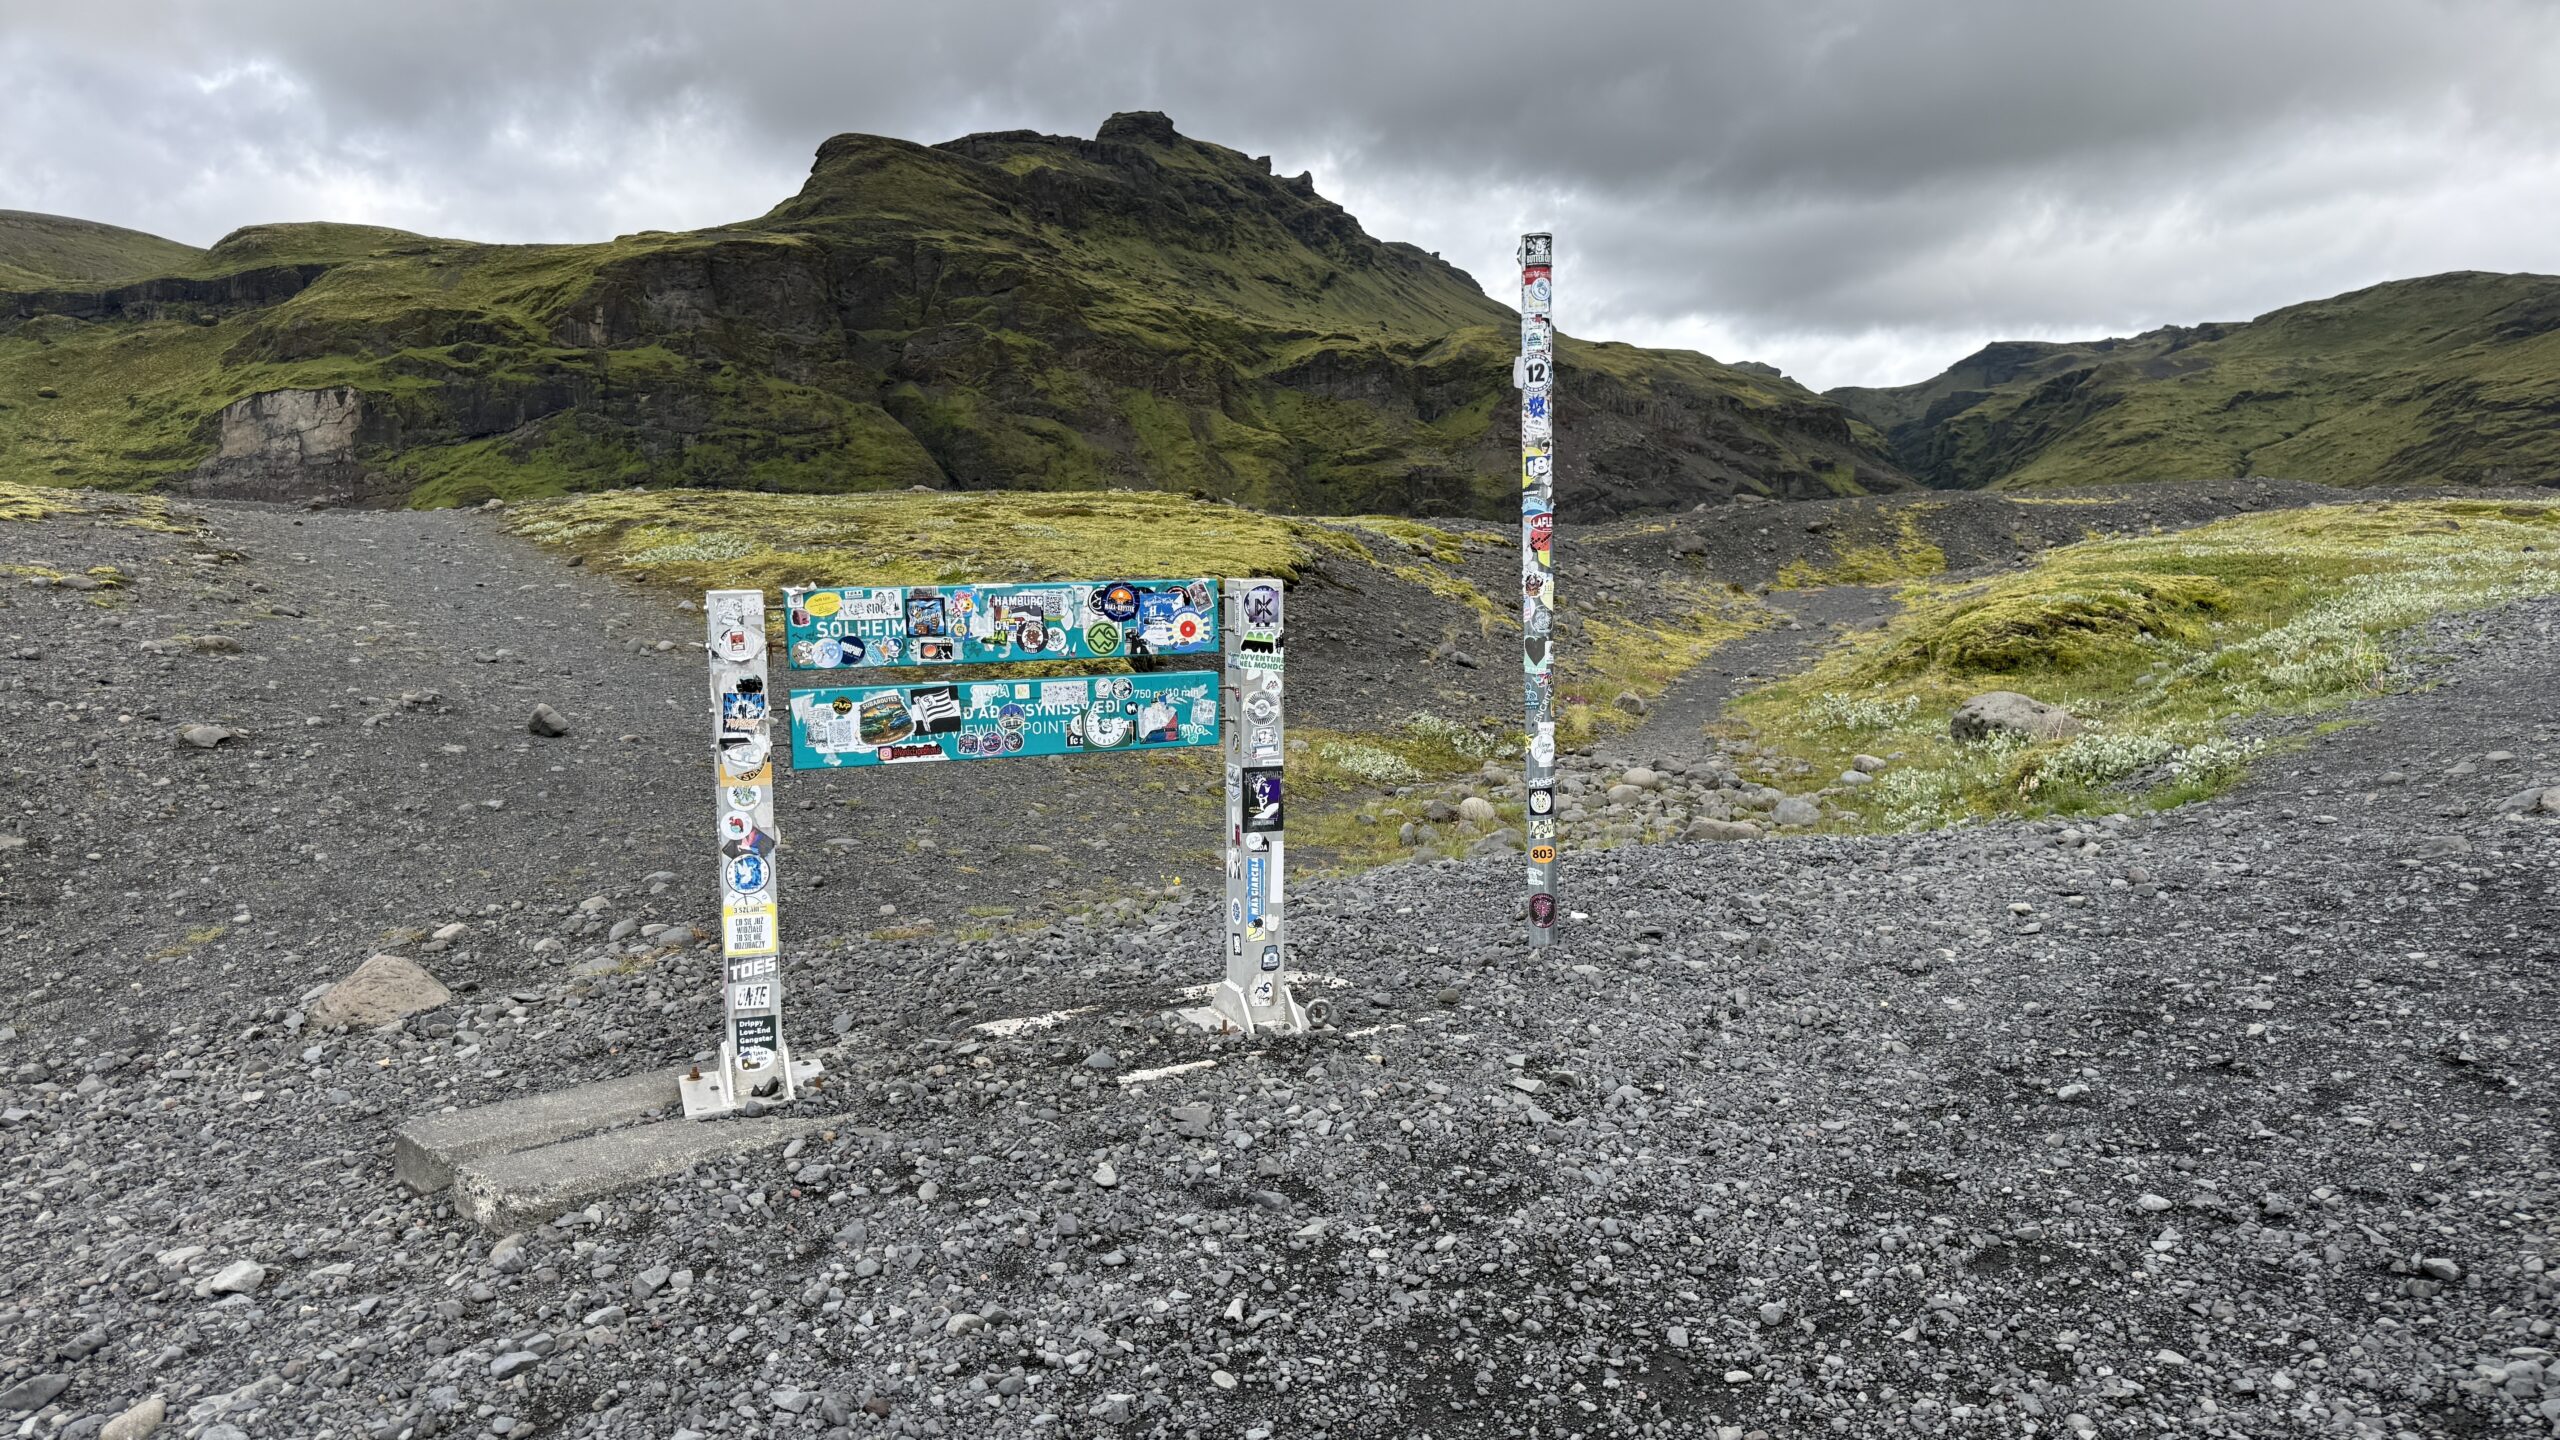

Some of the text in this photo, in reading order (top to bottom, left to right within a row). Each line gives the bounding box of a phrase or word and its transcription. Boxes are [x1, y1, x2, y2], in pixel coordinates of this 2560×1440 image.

[1526, 363, 1545, 383] 12
[994, 596, 1043, 607] HAMBURG
[1133, 689, 1151, 699] 750
[1022, 720, 1069, 735] POINT
[1532, 849, 1553, 859] 803
[739, 1020, 764, 1028] Drippy
[739, 1027, 771, 1036] Low-End
[739, 1035, 774, 1044] Gangster
